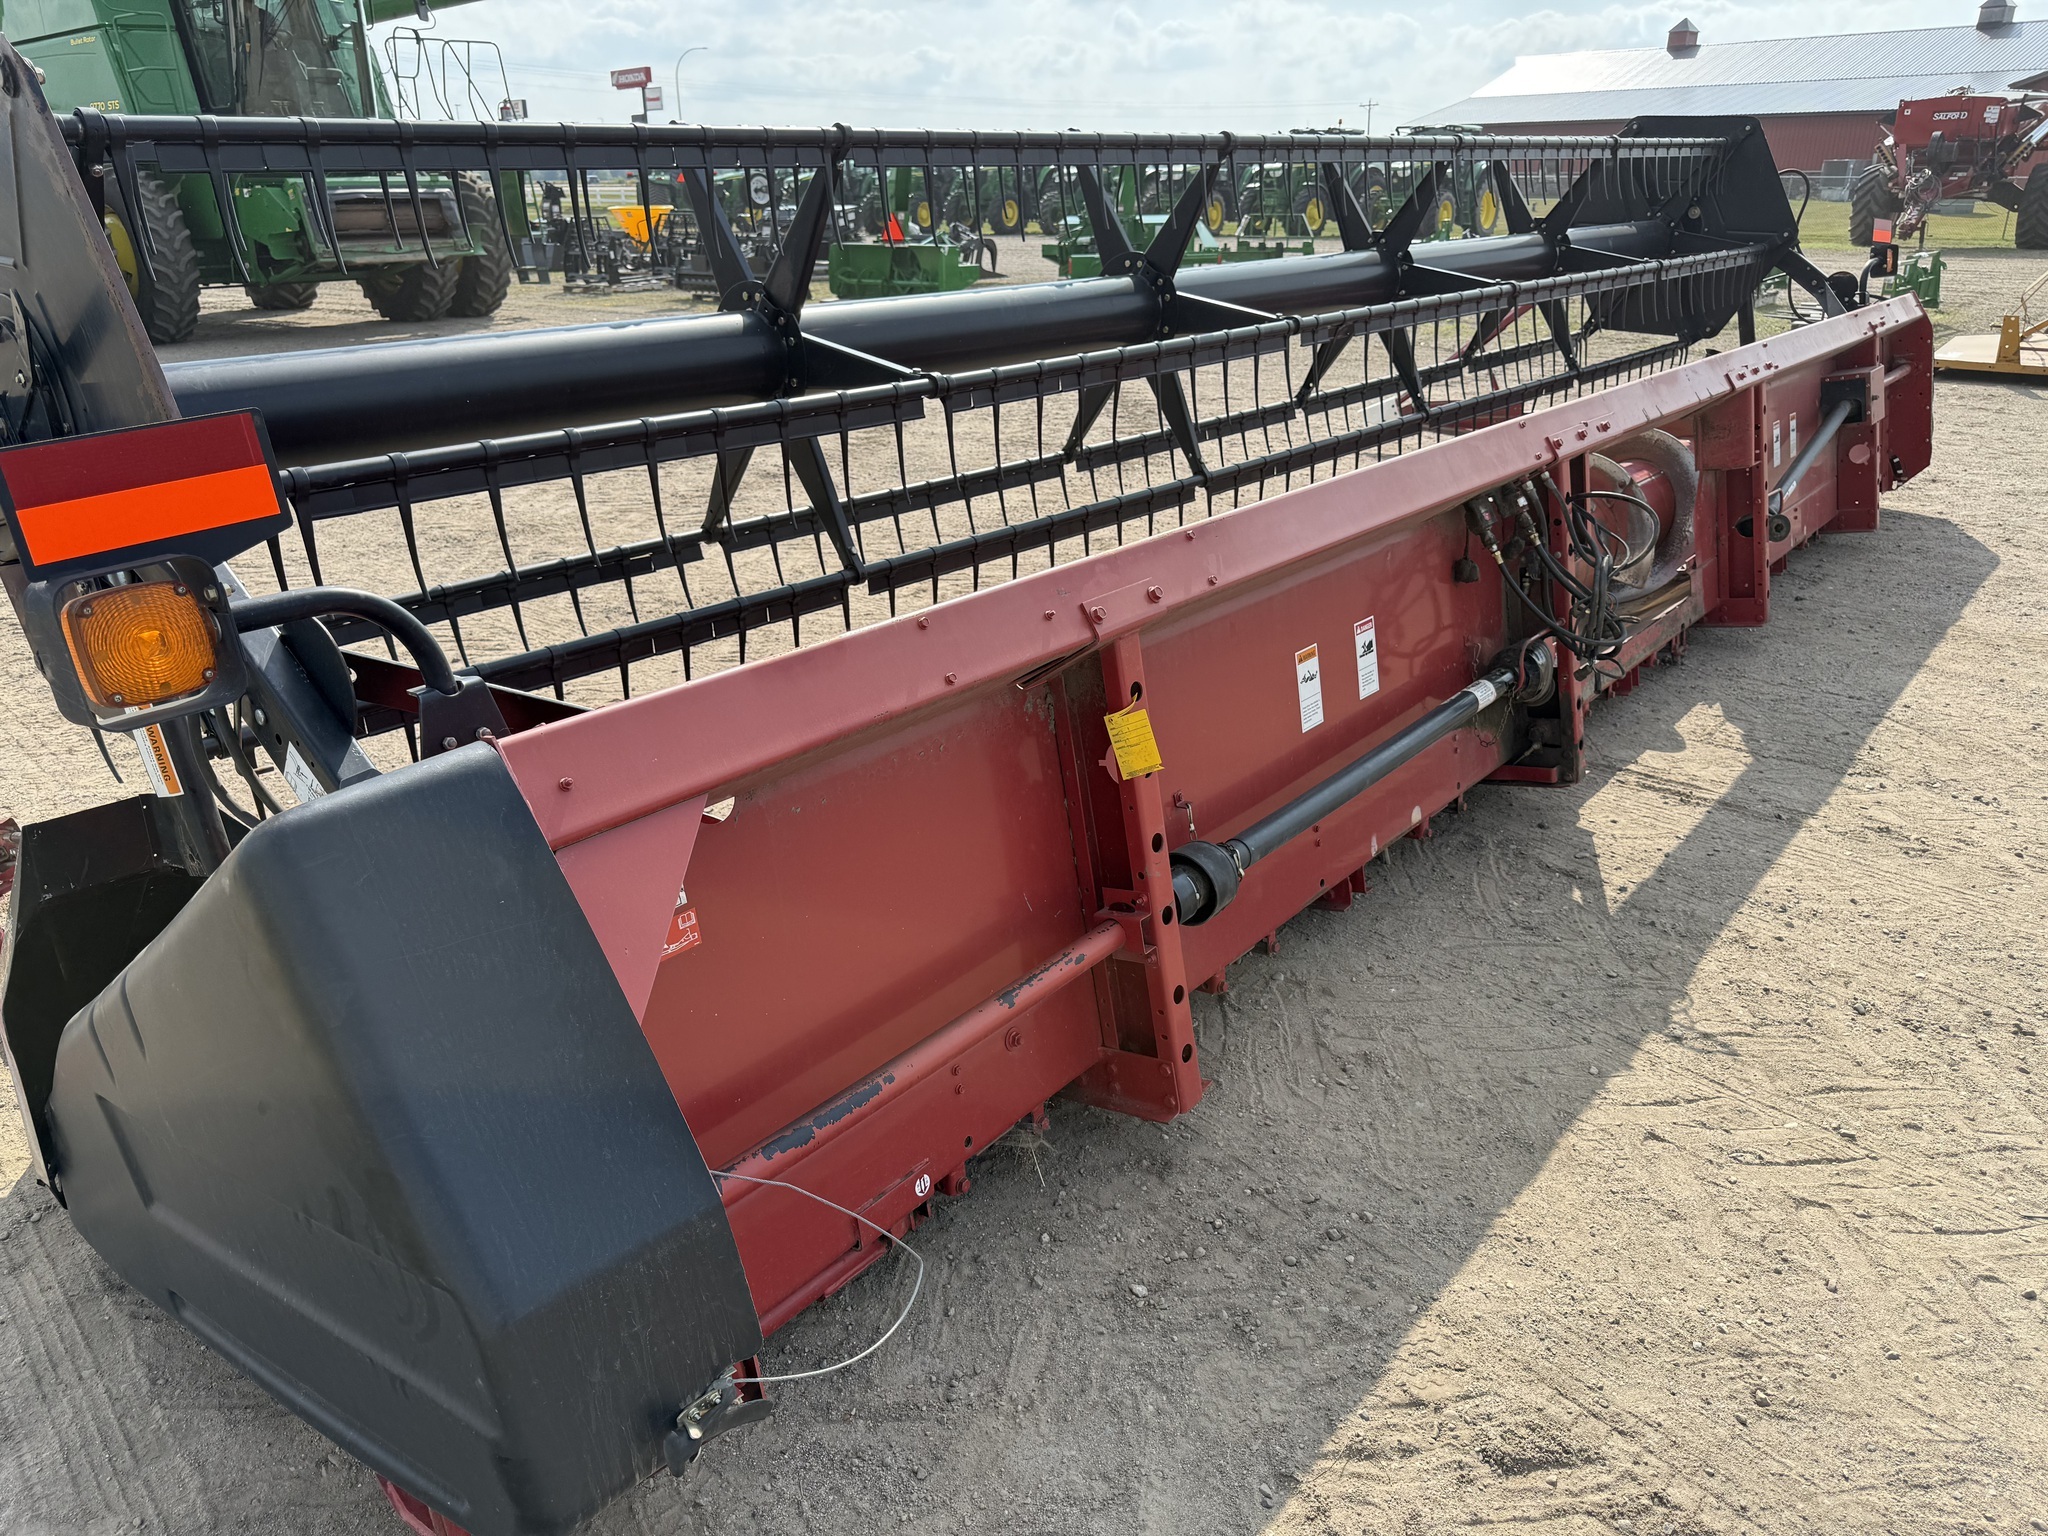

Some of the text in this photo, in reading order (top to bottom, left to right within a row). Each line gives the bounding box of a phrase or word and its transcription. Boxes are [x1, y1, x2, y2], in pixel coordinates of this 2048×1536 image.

[618, 72, 647, 83] HONDA
[107, 100, 120, 110] STS
[146, 726, 171, 782] WARNING
